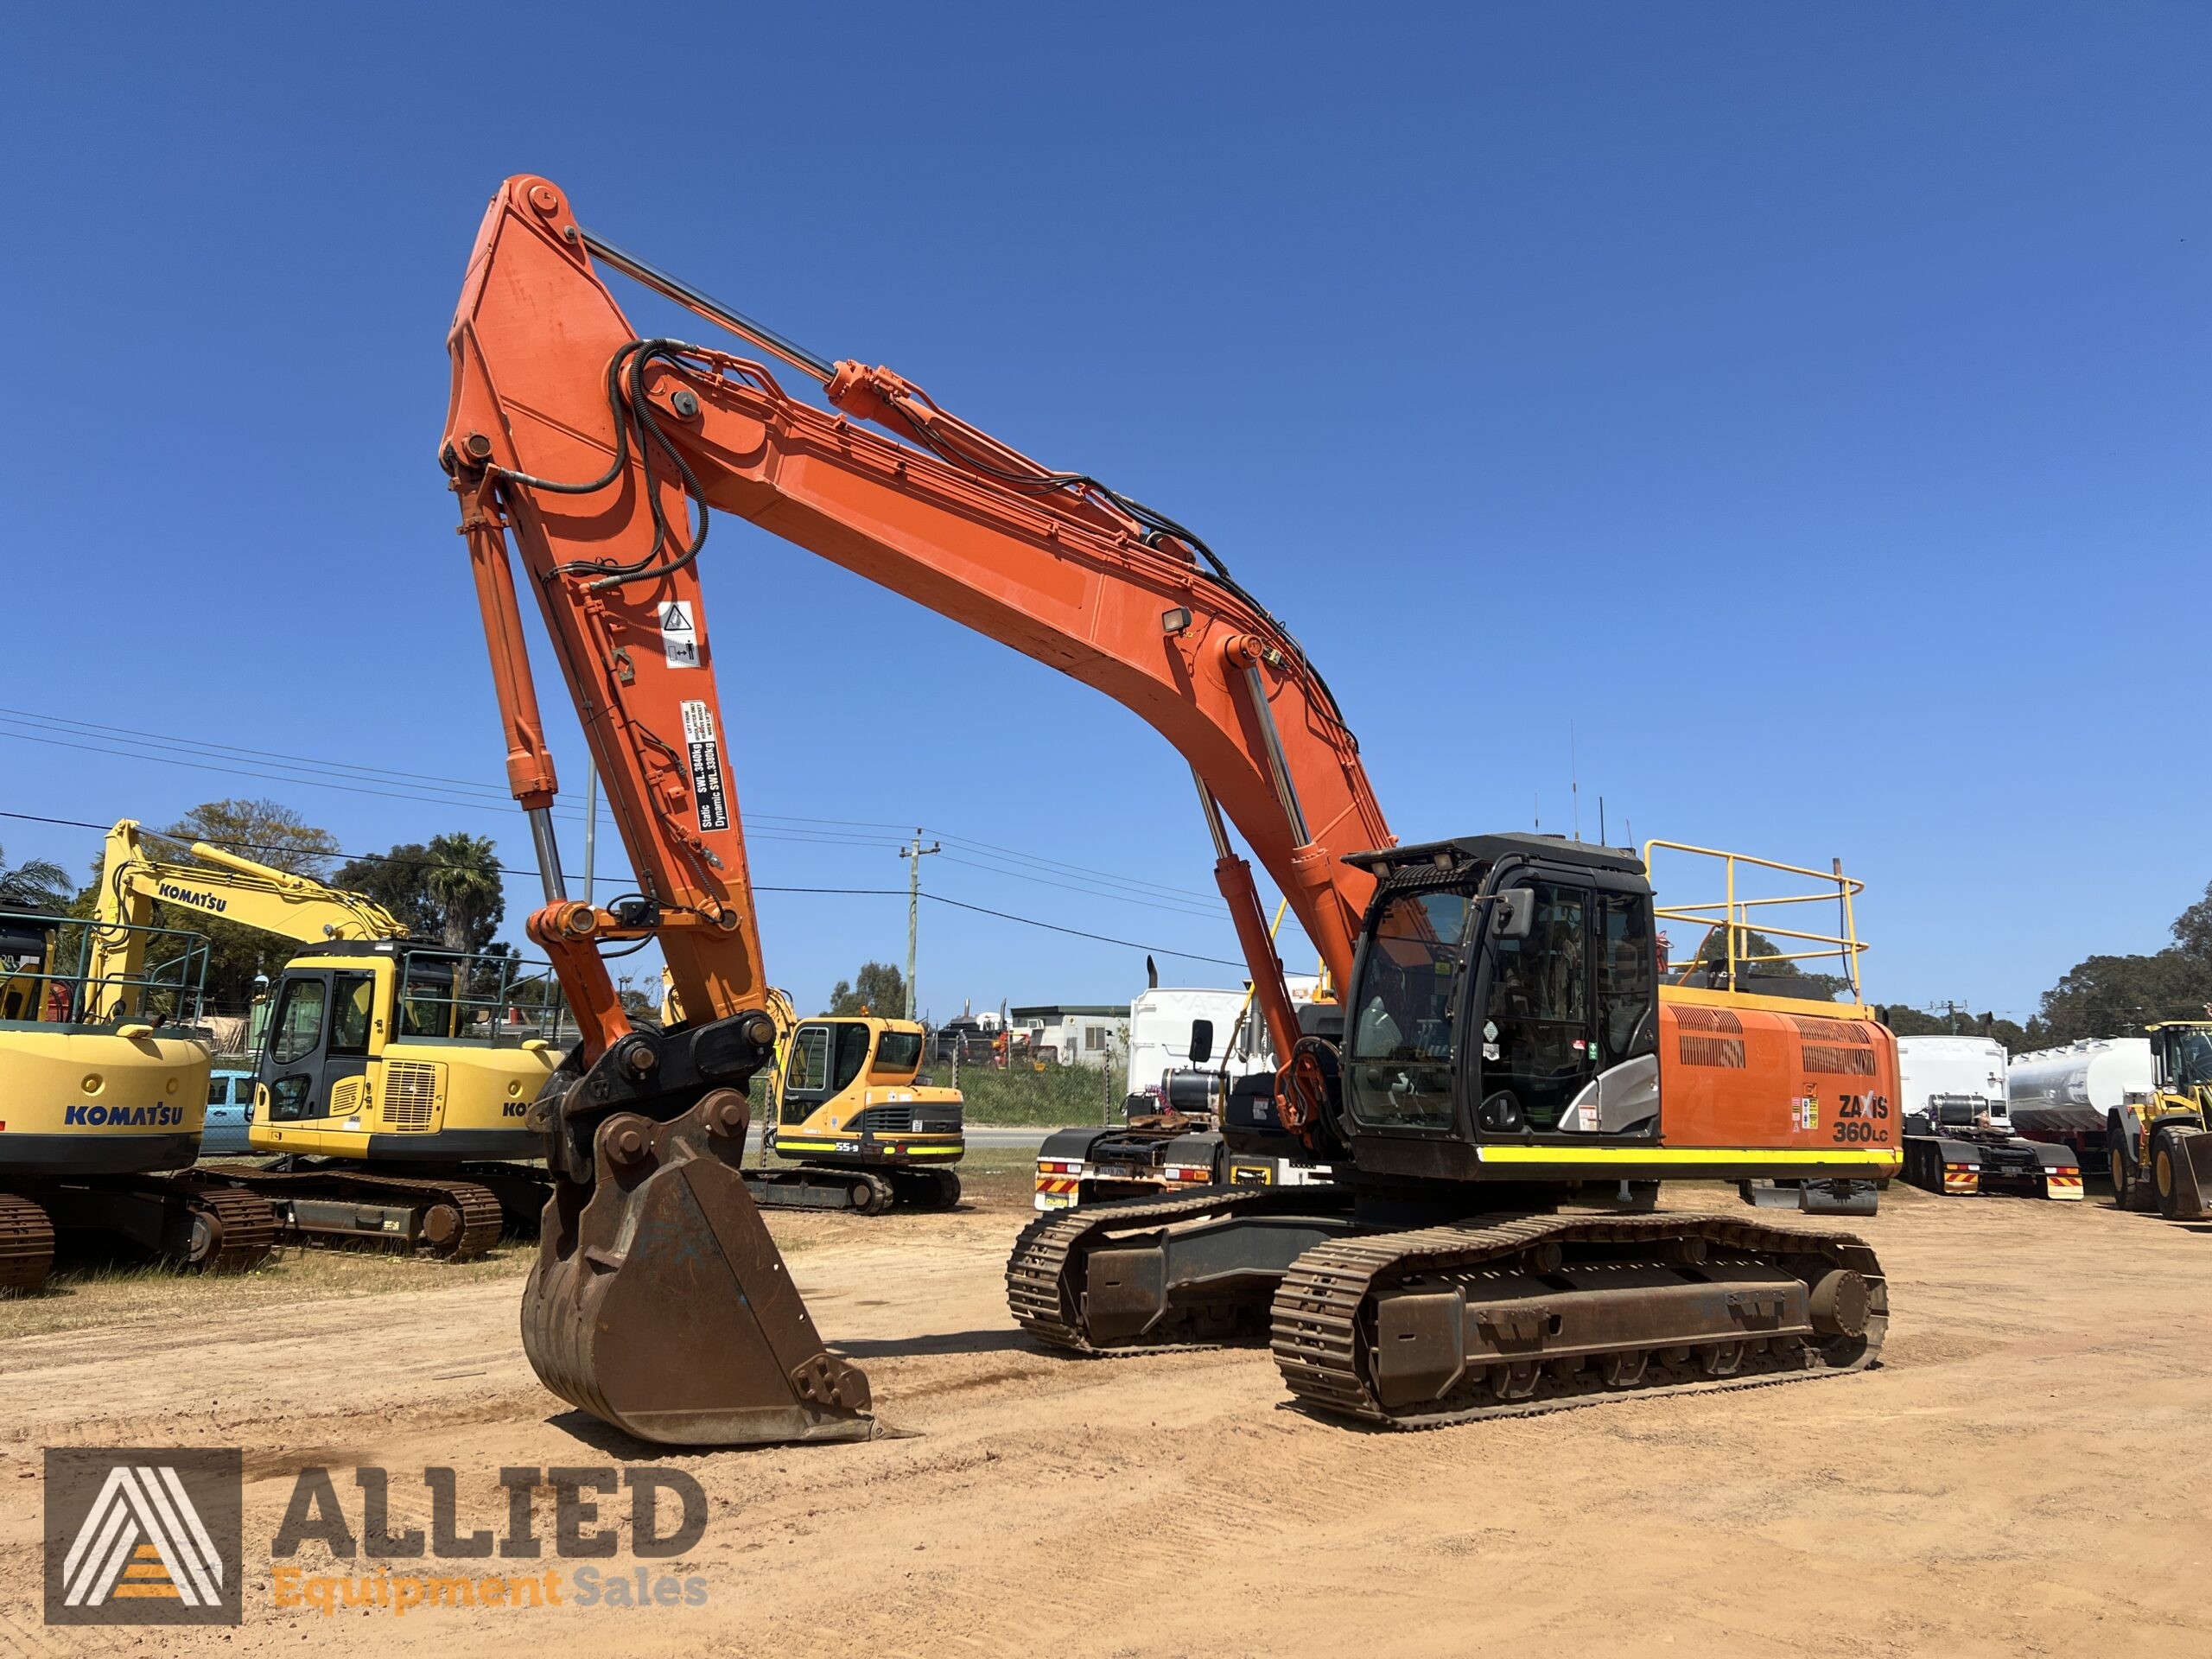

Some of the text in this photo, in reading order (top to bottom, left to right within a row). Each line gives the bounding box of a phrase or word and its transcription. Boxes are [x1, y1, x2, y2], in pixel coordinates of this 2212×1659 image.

[701, 804, 712, 828] Static
[711, 791, 726, 827] Dynamic
[159, 883, 227, 912] KOMATSU
[65, 1101, 184, 1126] KOMATSU
[503, 1102, 534, 1117] KO
[1839, 1090, 1889, 1119] ZAXIS
[836, 1142, 859, 1153] 55-9
